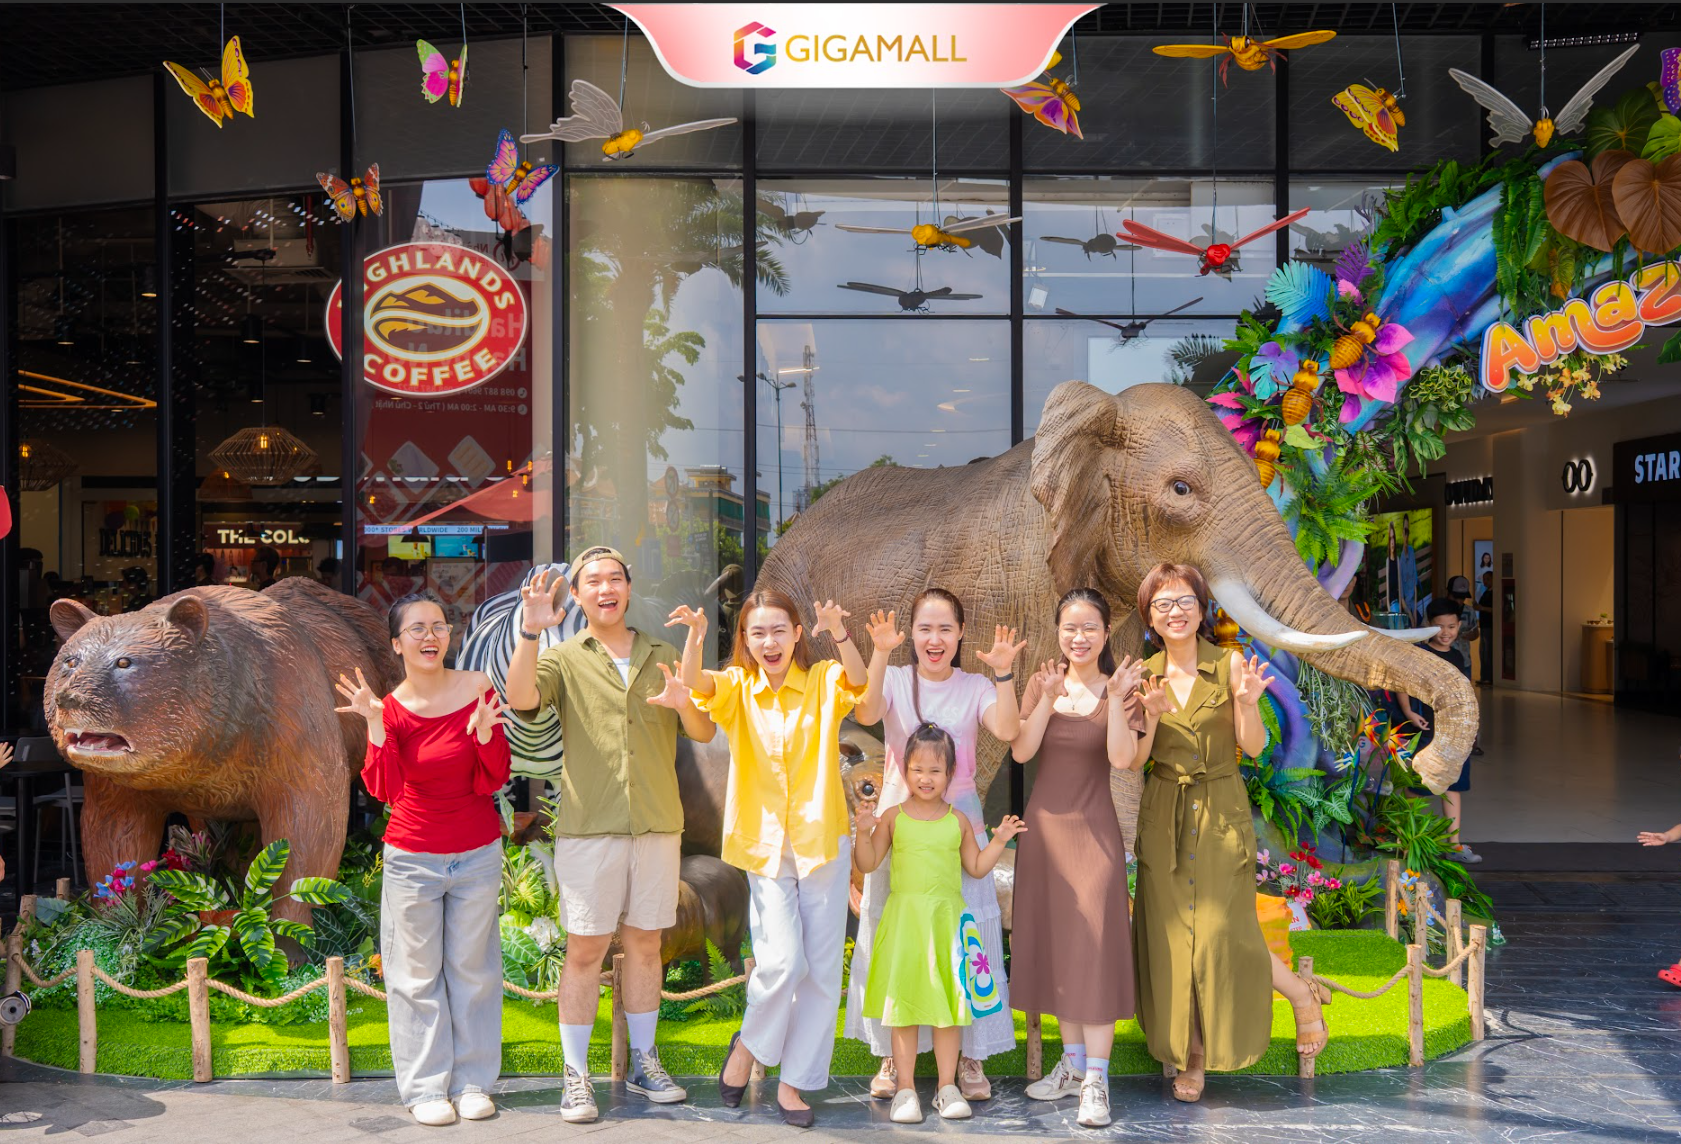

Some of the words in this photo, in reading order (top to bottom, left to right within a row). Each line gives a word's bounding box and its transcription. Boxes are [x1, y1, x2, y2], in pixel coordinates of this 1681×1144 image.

[364, 250, 516, 310] GHLANDS
[364, 347, 498, 387] COFFEE
[1634, 450, 1681, 484] STAR
[407, 526, 448, 534] WRLDWIDE
[456, 526, 469, 534] 200
